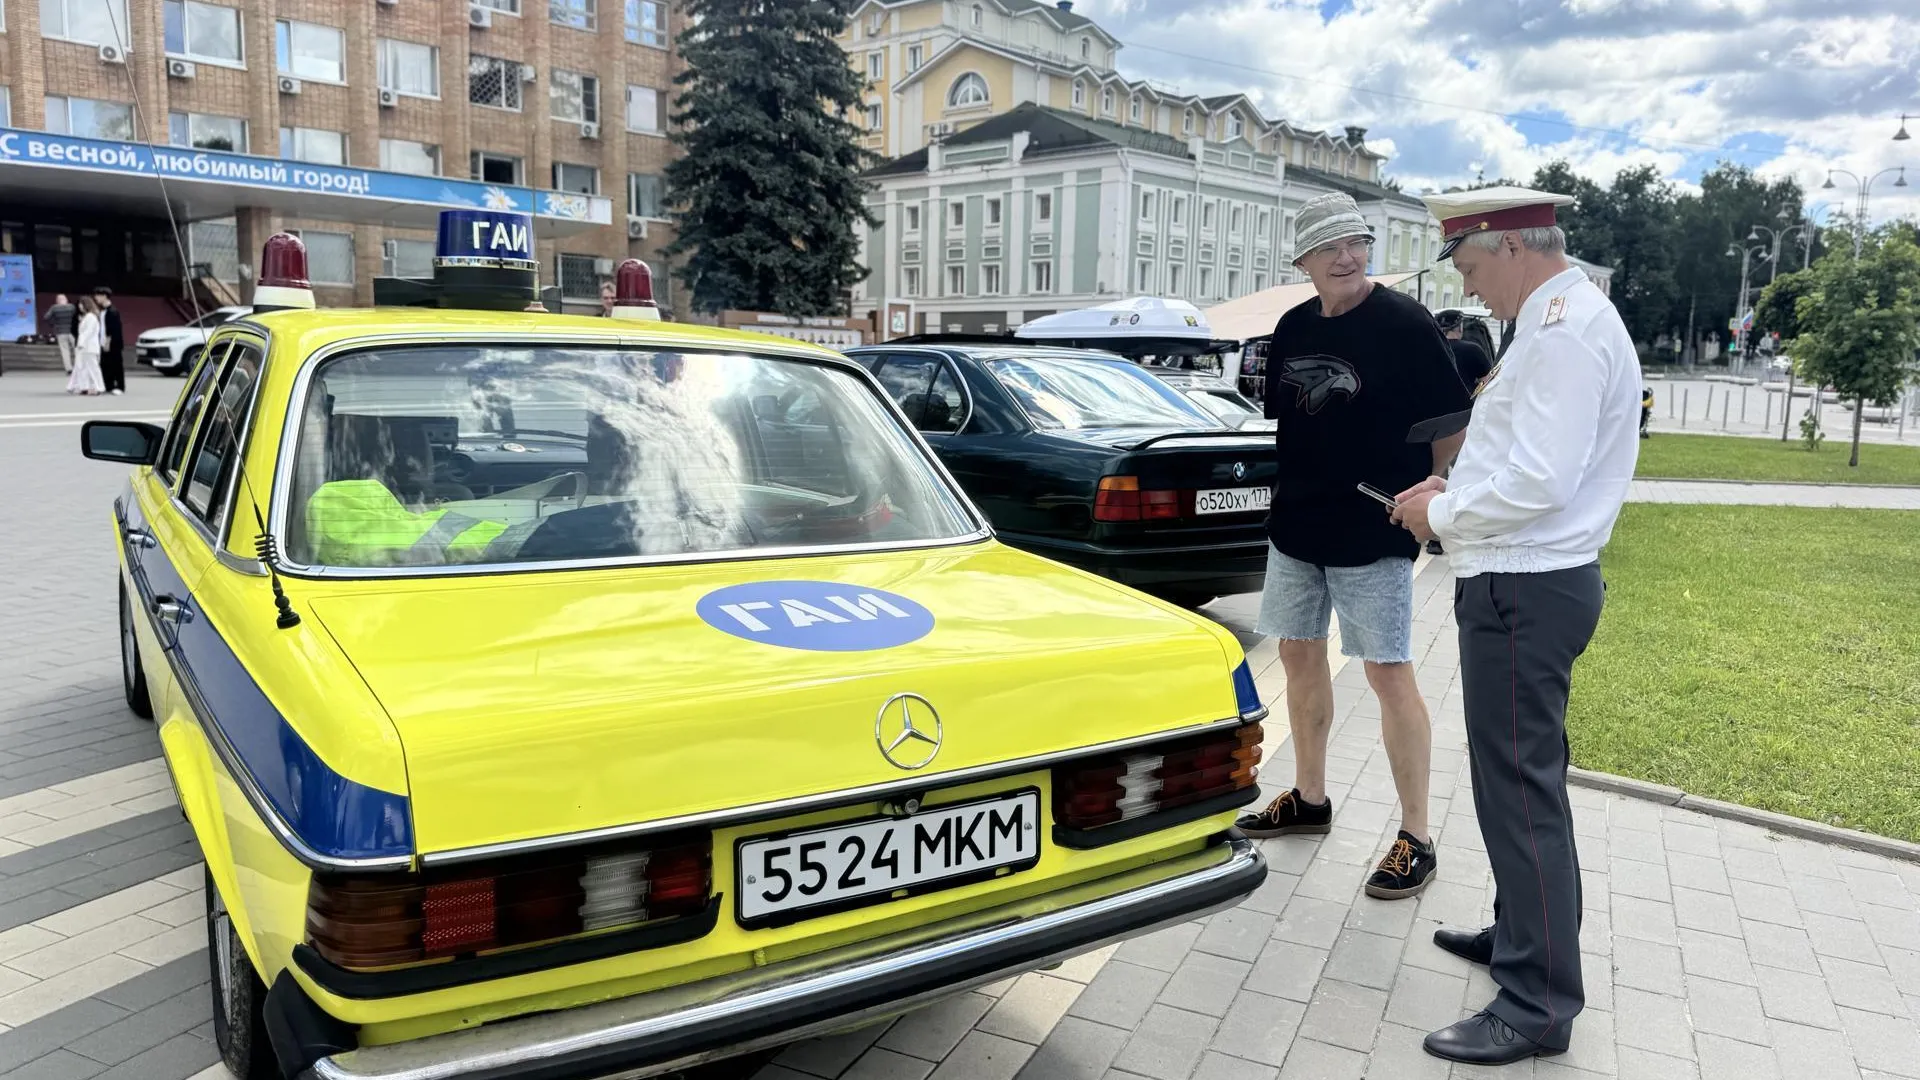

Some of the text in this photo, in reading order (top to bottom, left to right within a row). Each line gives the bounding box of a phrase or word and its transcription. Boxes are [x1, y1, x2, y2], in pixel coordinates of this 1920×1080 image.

[0, 132, 370, 194] С весной, любимый город!
[472, 221, 528, 253] ГАИ
[717, 593, 912, 632] ГАИ
[761, 803, 1024, 903] 5524 МКМ
